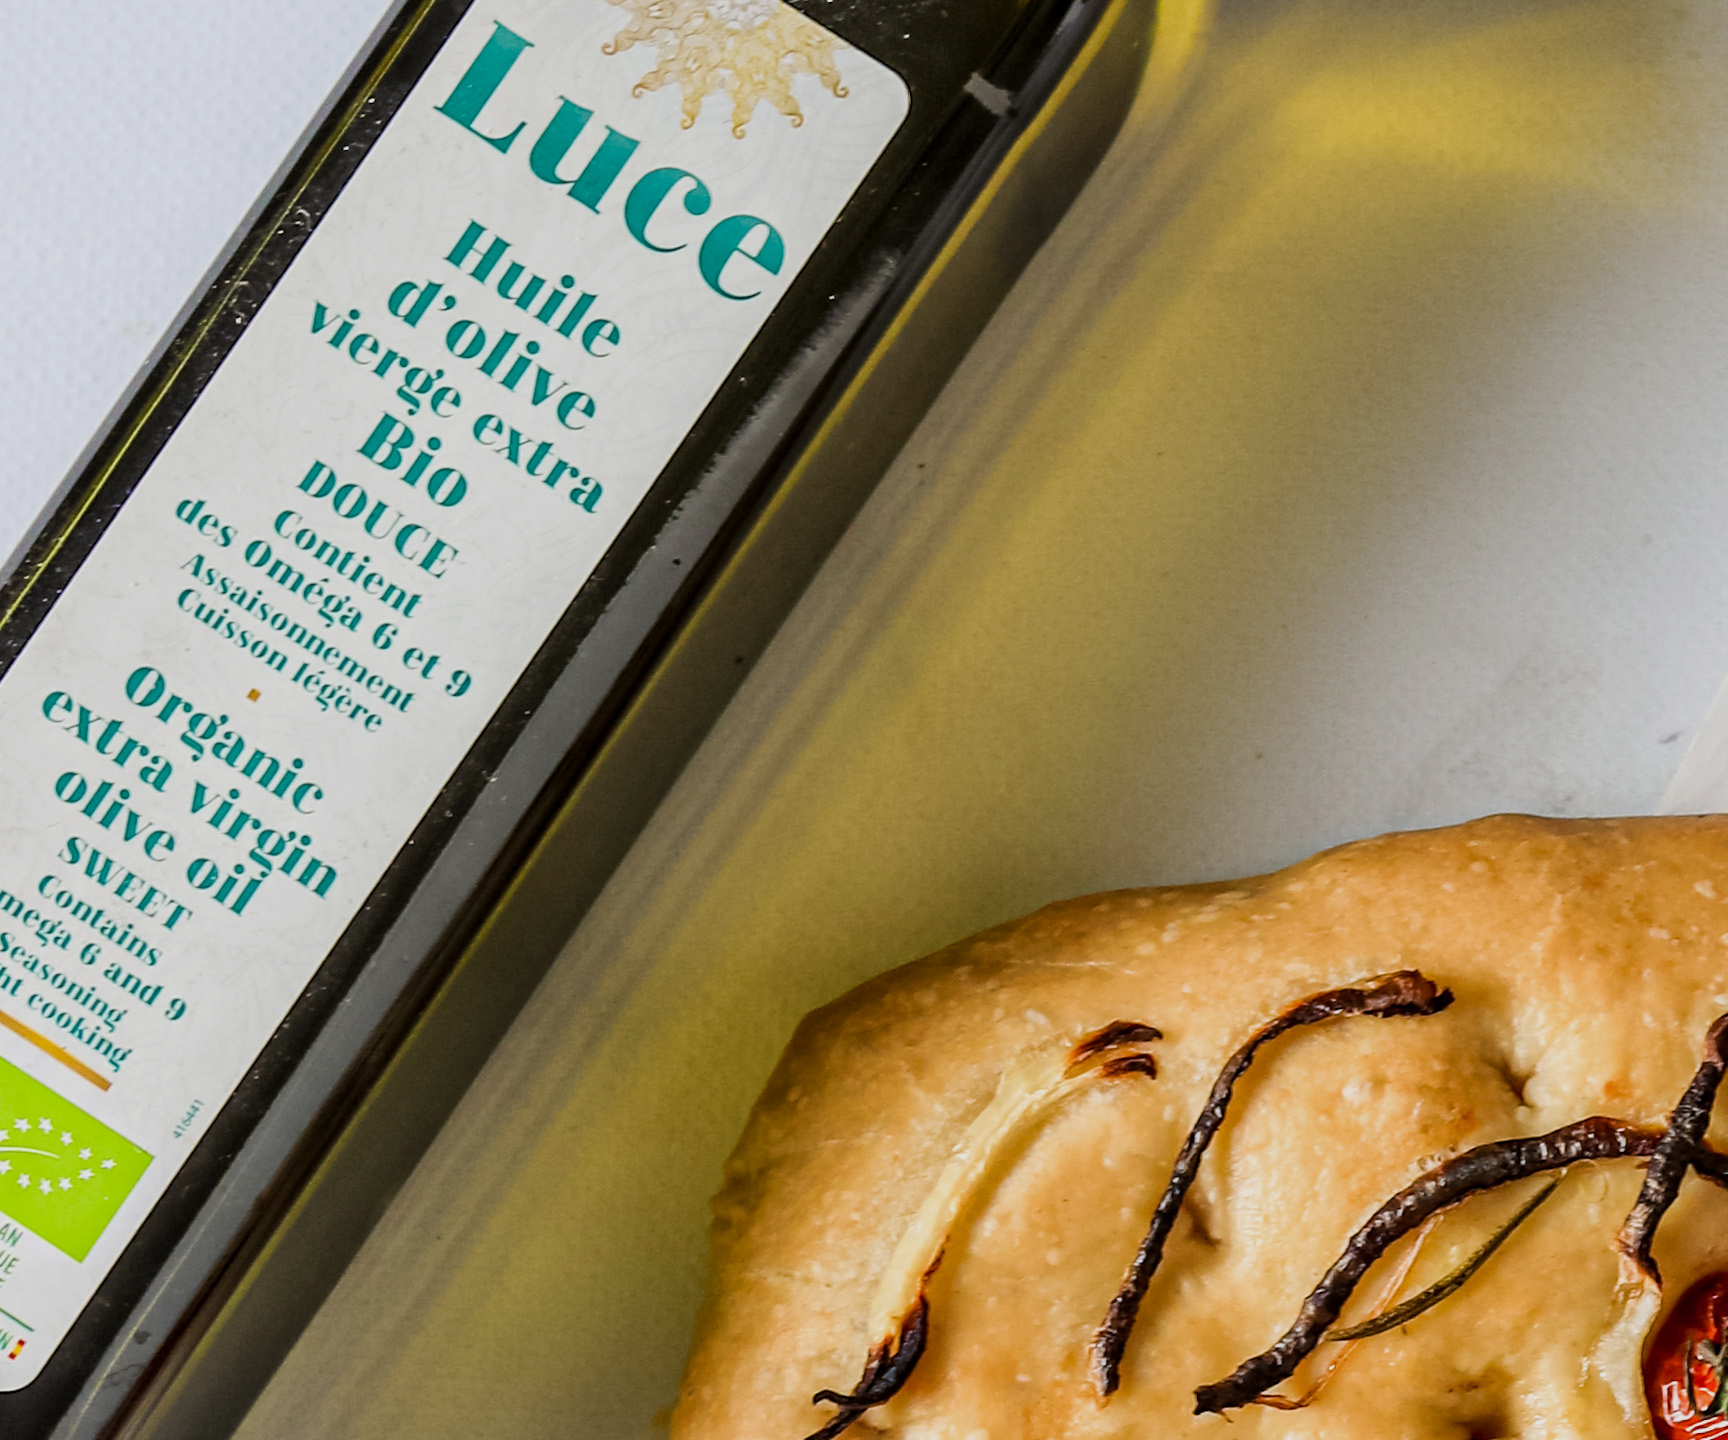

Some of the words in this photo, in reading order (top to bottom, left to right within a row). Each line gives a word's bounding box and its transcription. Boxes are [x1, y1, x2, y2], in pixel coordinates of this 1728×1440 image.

[433, 20, 786, 302] Luce
[445, 220, 621, 357] Huile
[310, 302, 462, 417] vierge
[472, 414, 604, 514] extra
[356, 412, 468, 509] Bio
[273, 510, 422, 619] Contient
[297, 460, 459, 579] DOUCE
[175, 499, 238, 547] des
[244, 539, 364, 629] Oméga
[371, 623, 398, 650] 6
[402, 648, 440, 680] et
[445, 670, 472, 698] 9
[177, 588, 288, 673] Cuisson
[291, 662, 383, 733] légère
[180, 553, 415, 713] Assaisonnement
[41, 691, 174, 793] extra
[190, 781, 338, 899] virgin
[124, 667, 324, 814] Organic
[54, 771, 175, 861] olive
[186, 858, 263, 916] oil
[57, 837, 193, 931] SWEET
[0, 890, 72, 950] mega
[79, 943, 101, 965] 6
[104, 963, 163, 1006] and
[165, 998, 187, 1021] 9
[38, 875, 162, 966] Contains
[28, 994, 132, 1072] cooking
